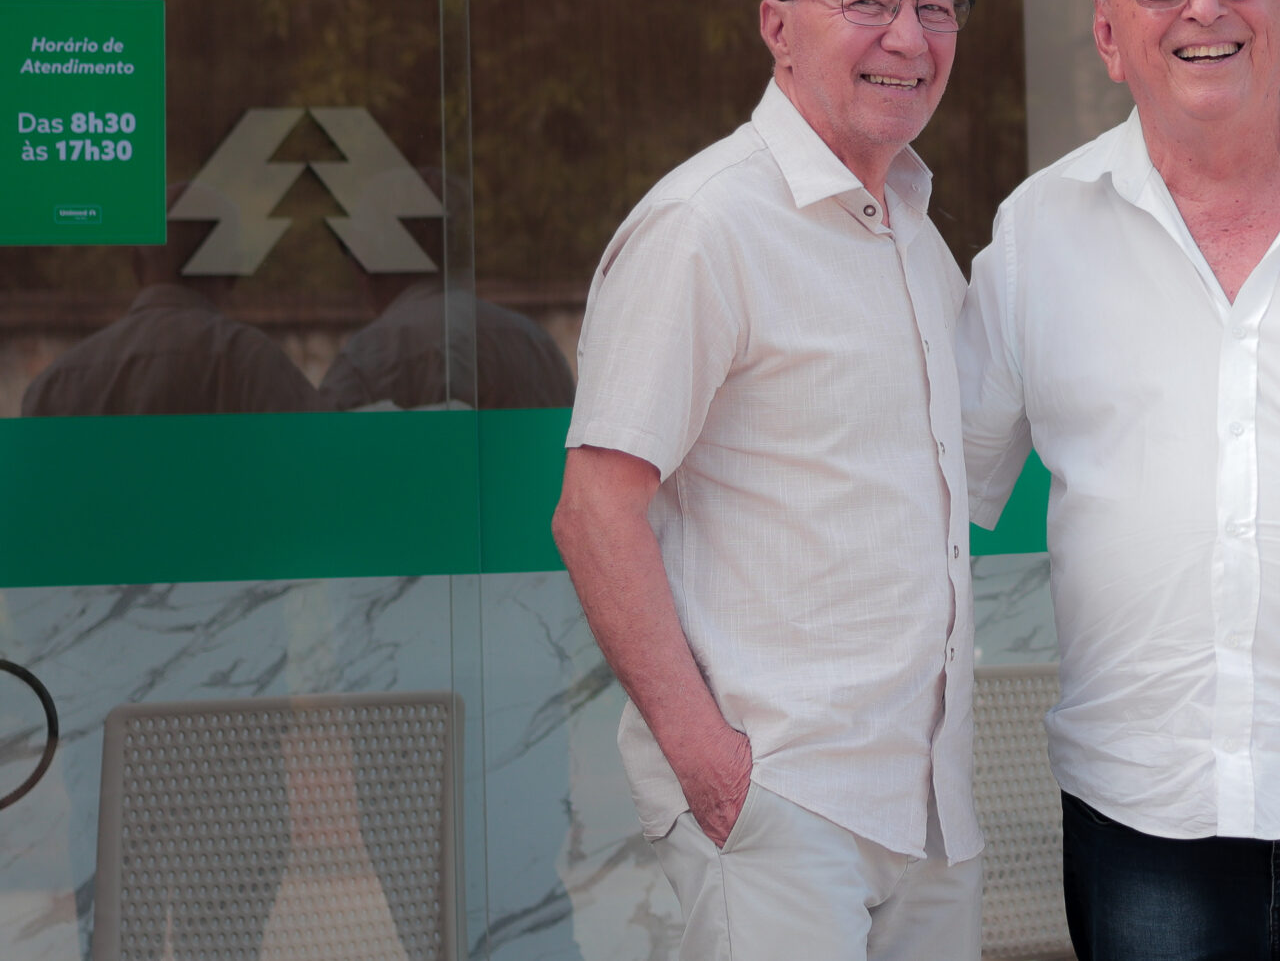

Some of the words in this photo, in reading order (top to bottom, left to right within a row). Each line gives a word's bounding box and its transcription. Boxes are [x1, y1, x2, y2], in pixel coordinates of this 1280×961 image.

[31, 36, 98, 53] Horário
[102, 36, 124, 53] de
[20, 59, 135, 74] Atendimento
[18, 112, 64, 133] Das
[70, 111, 136, 133] 8h30
[21, 140, 48, 161] às
[56, 139, 133, 161] 17h30
